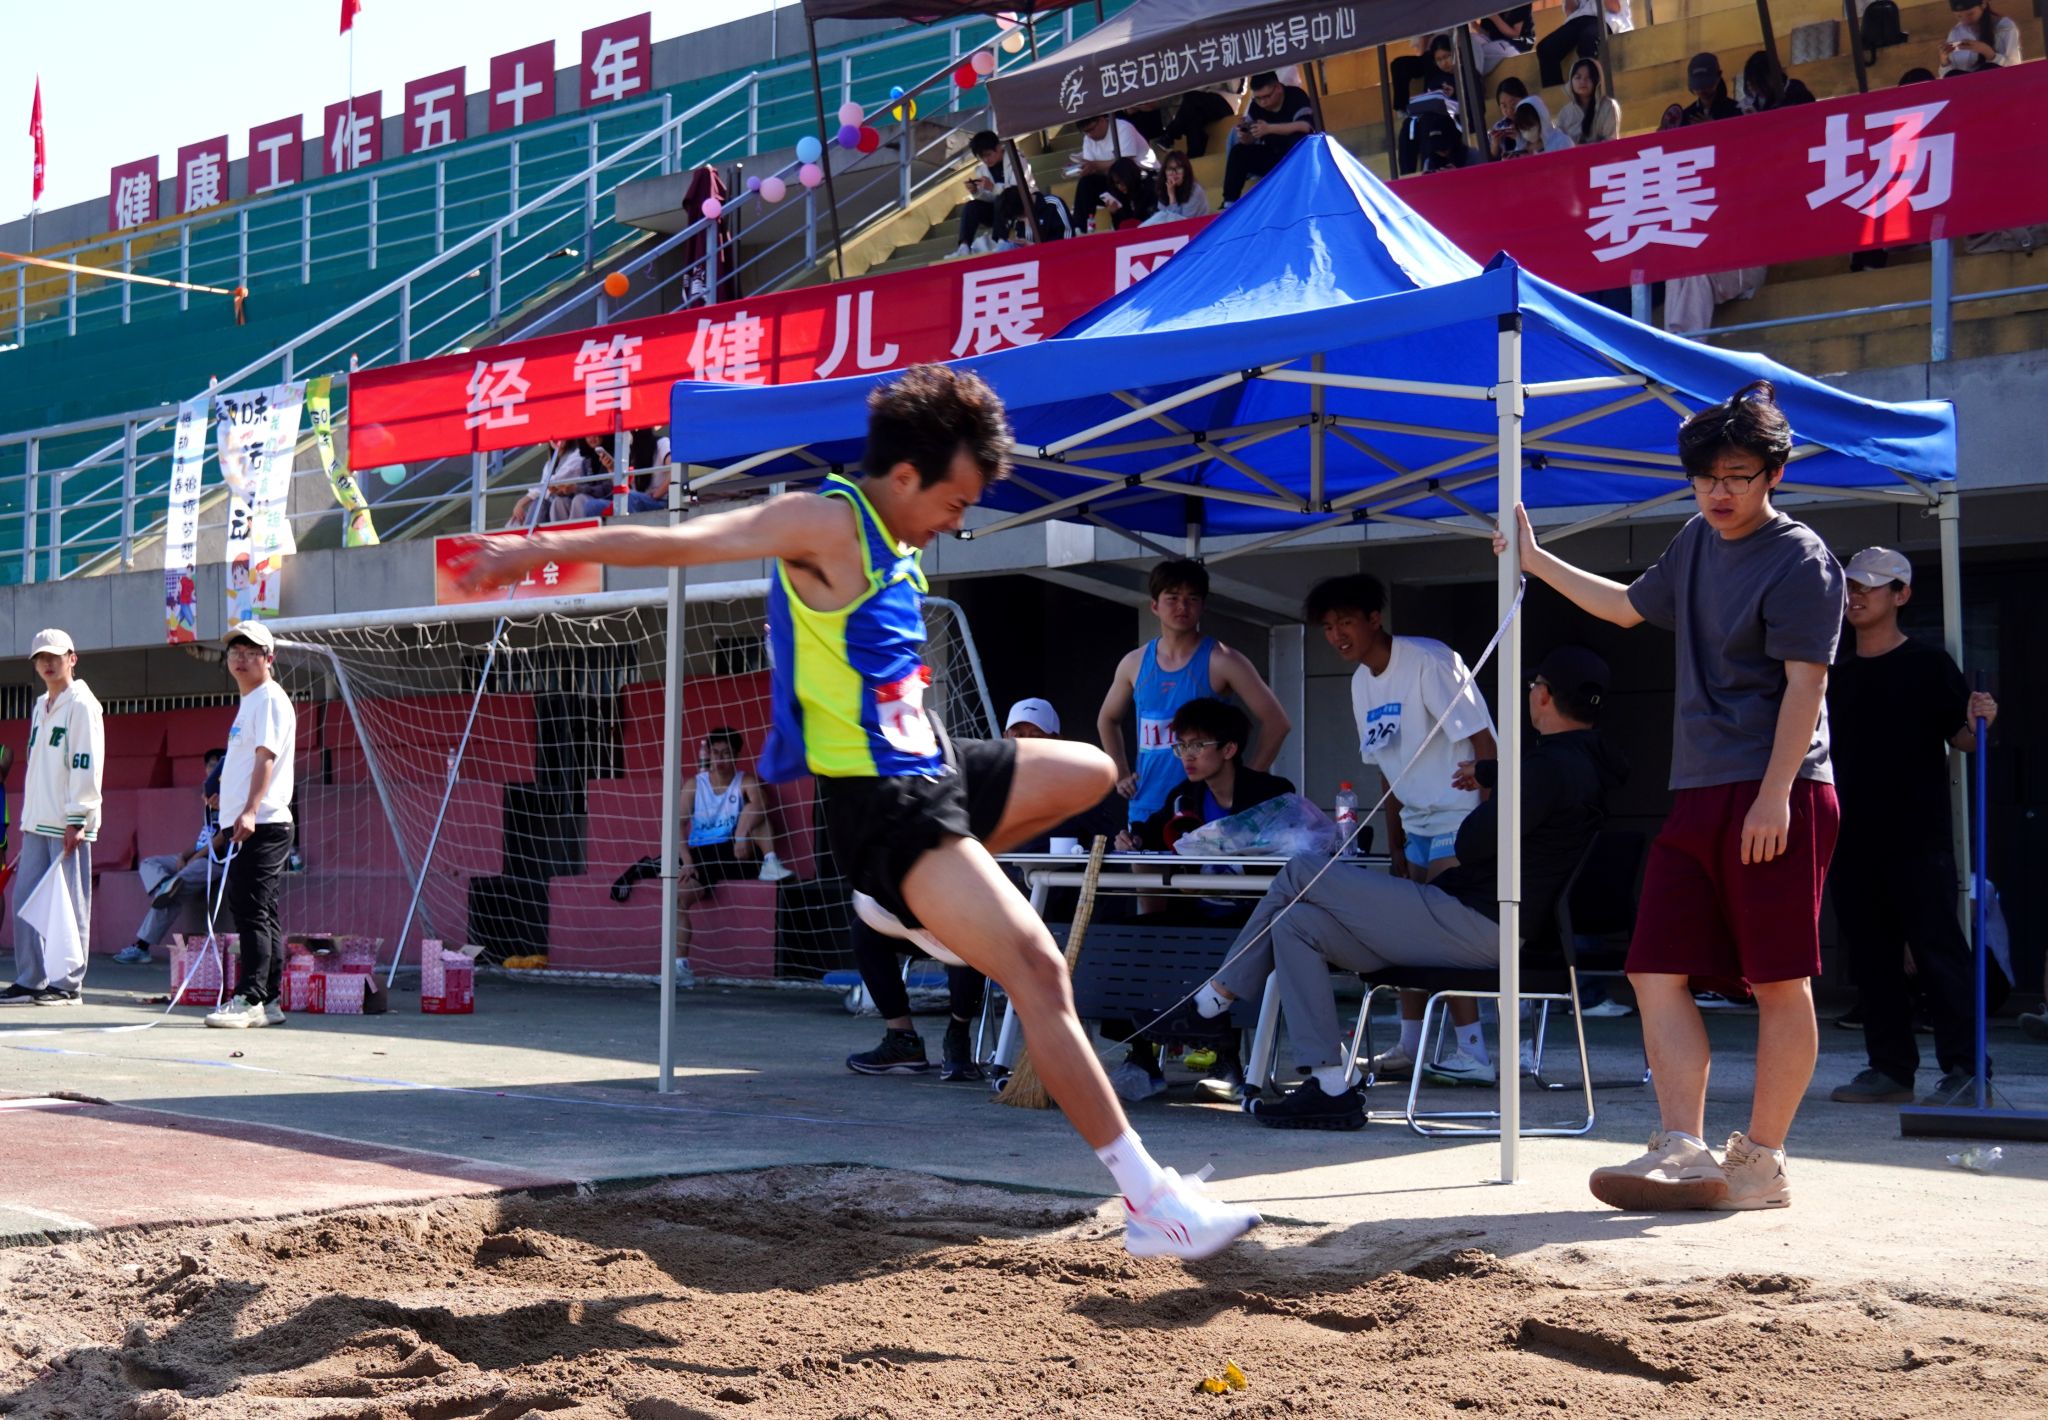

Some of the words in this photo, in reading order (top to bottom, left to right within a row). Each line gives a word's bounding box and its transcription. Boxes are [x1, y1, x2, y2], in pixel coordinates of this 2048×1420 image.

[1100, 7, 1356, 98] 西安石油大学就业指导中心
[114, 36, 641, 230] 健康工作五十年
[1583, 100, 1957, 263] 赛场
[72, 753, 90, 770] 60
